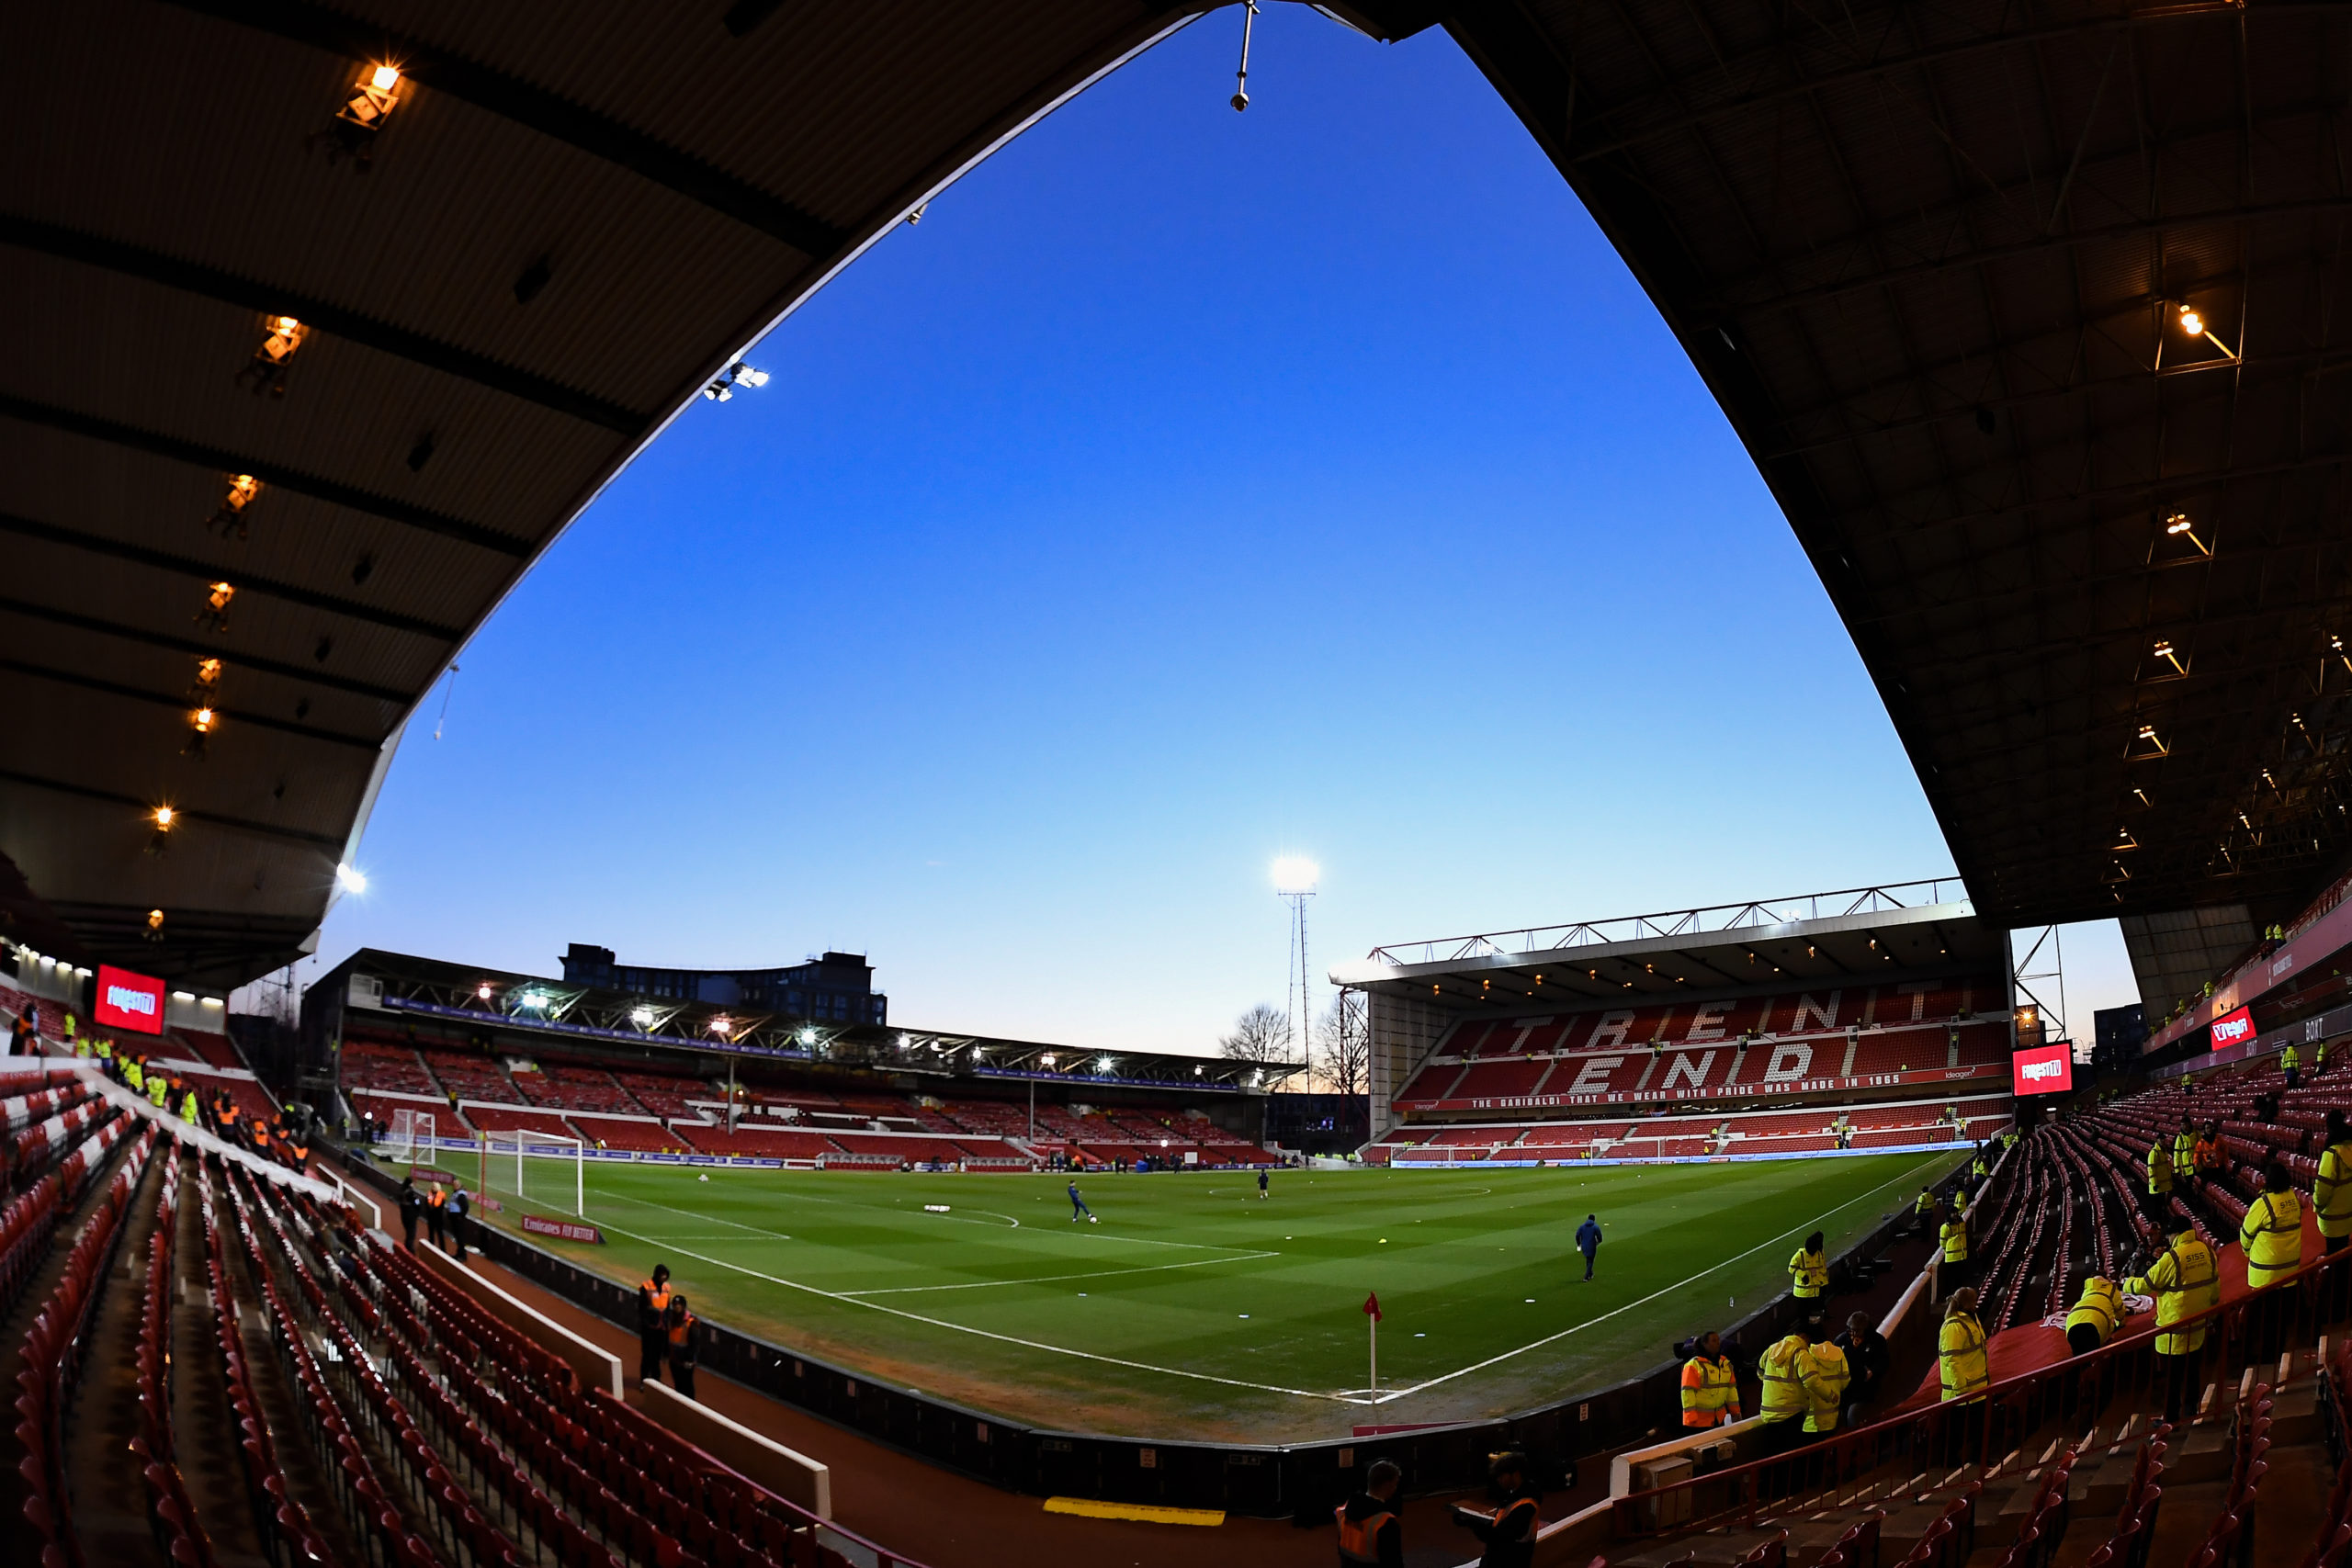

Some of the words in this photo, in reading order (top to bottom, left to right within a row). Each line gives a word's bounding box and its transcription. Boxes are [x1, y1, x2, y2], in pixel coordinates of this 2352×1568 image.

[1510, 979, 1942, 1053] TRENT
[2305, 1018, 2324, 1041] BOXT
[1567, 1043, 1813, 1093] END
[1945, 1069, 1973, 1079] Ideagen
[1473, 1100, 1492, 1108] THE
[1500, 1097, 1560, 1108] GARIBALDI
[1570, 1094, 1598, 1104] THAT
[1608, 1093, 1623, 1102] WE
[1634, 1090, 1667, 1101] WEAR
[1677, 1089, 1707, 1099] WITH
[1717, 1086, 1754, 1096] PRIDE
[1764, 1083, 1791, 1093] WAS
[1801, 1079, 1835, 1090] MADE
[1845, 1077, 1858, 1087] IN
[1869, 1075, 1900, 1086] 1865
